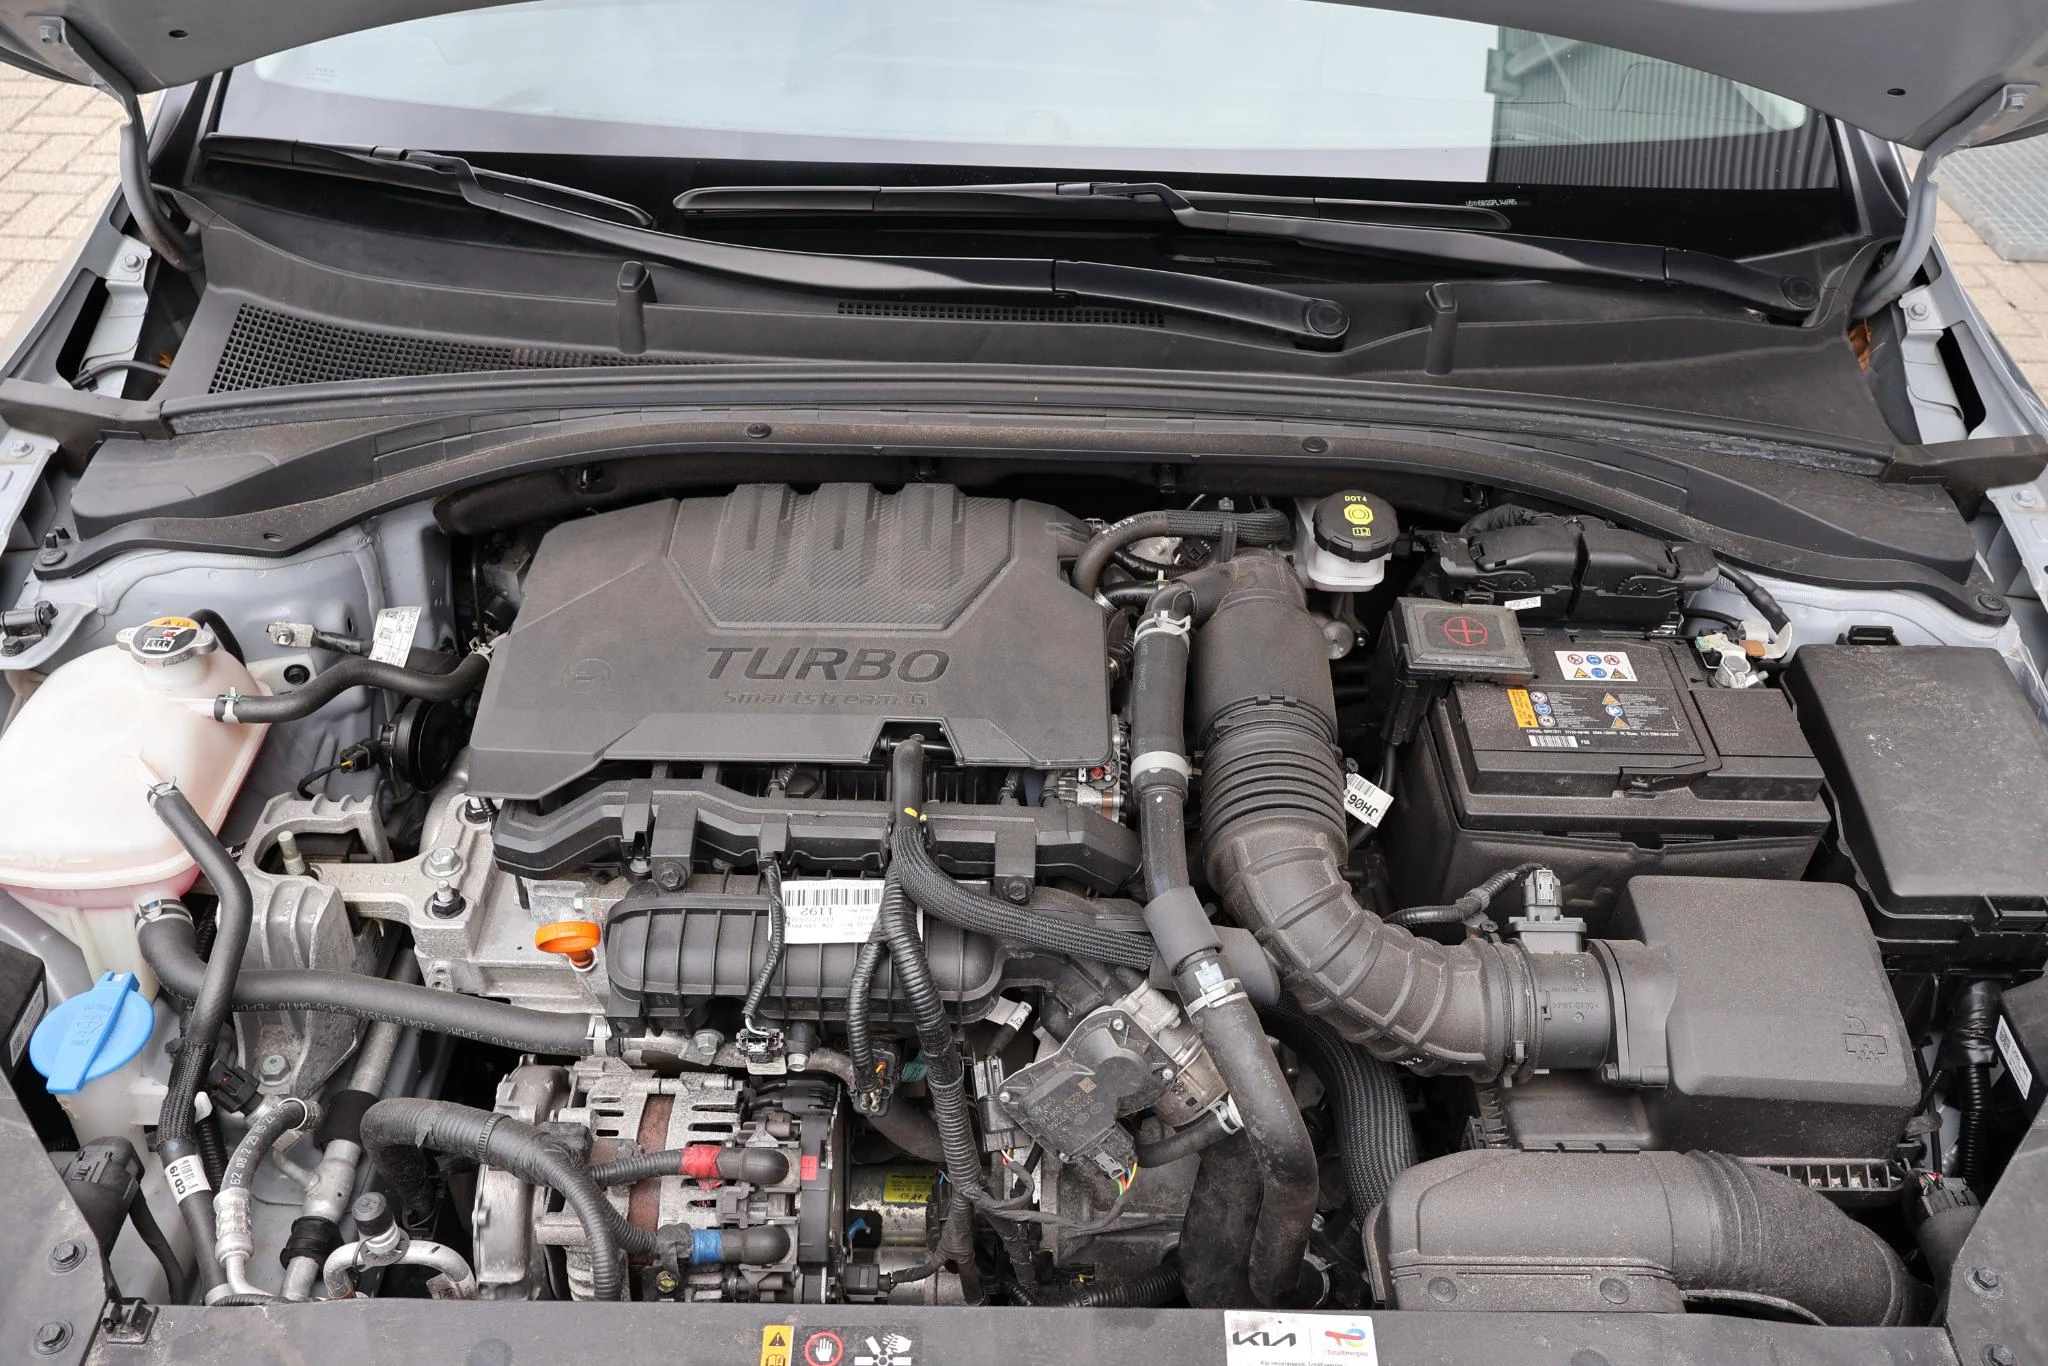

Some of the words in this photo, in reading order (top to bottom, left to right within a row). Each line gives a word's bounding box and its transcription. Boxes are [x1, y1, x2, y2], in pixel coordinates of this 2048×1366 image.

[706, 647, 950, 683] TURBO
[725, 690, 898, 705] Smartstream
[911, 694, 925, 705] G
[800, 907, 833, 916] 1192
[1232, 1331, 1297, 1347] KIA
